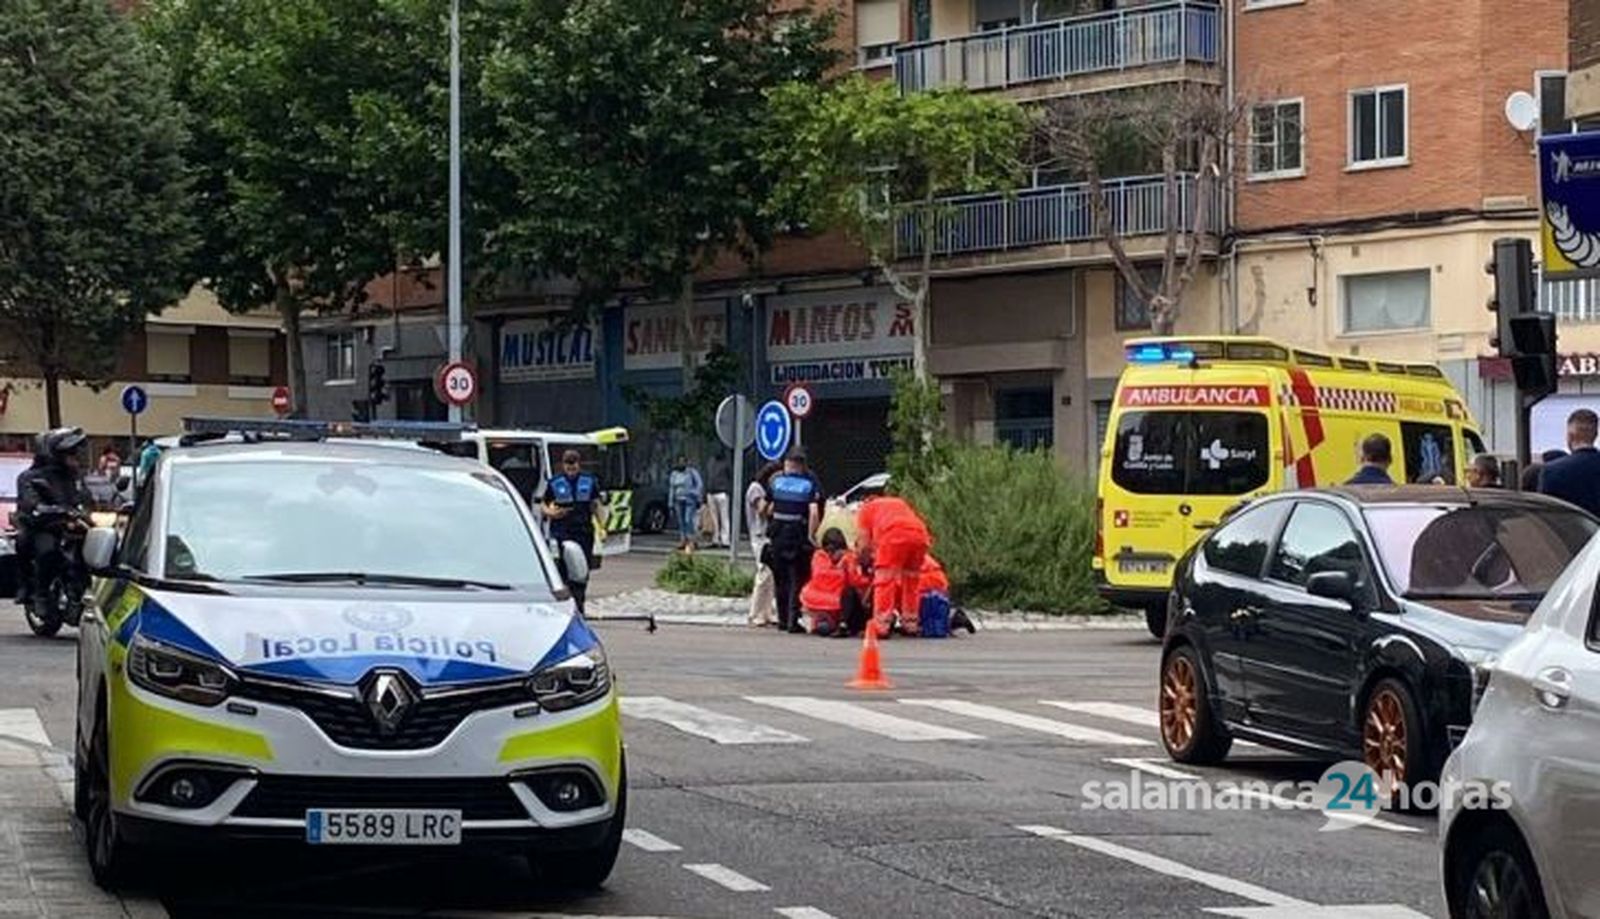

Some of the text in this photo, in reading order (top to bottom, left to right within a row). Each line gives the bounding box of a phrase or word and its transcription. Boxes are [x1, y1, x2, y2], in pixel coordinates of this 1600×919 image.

[627, 301, 878, 355] SANCEZ MARCOS
[503, 325, 592, 368] MUSICAL
[774, 361, 865, 382] LIQUIDACION
[1557, 357, 1600, 375] AB
[449, 376, 469, 391] 30
[792, 394, 807, 408] 30
[1127, 387, 1260, 405] AMBULANCIA
[328, 813, 454, 839] 5589 LRC
